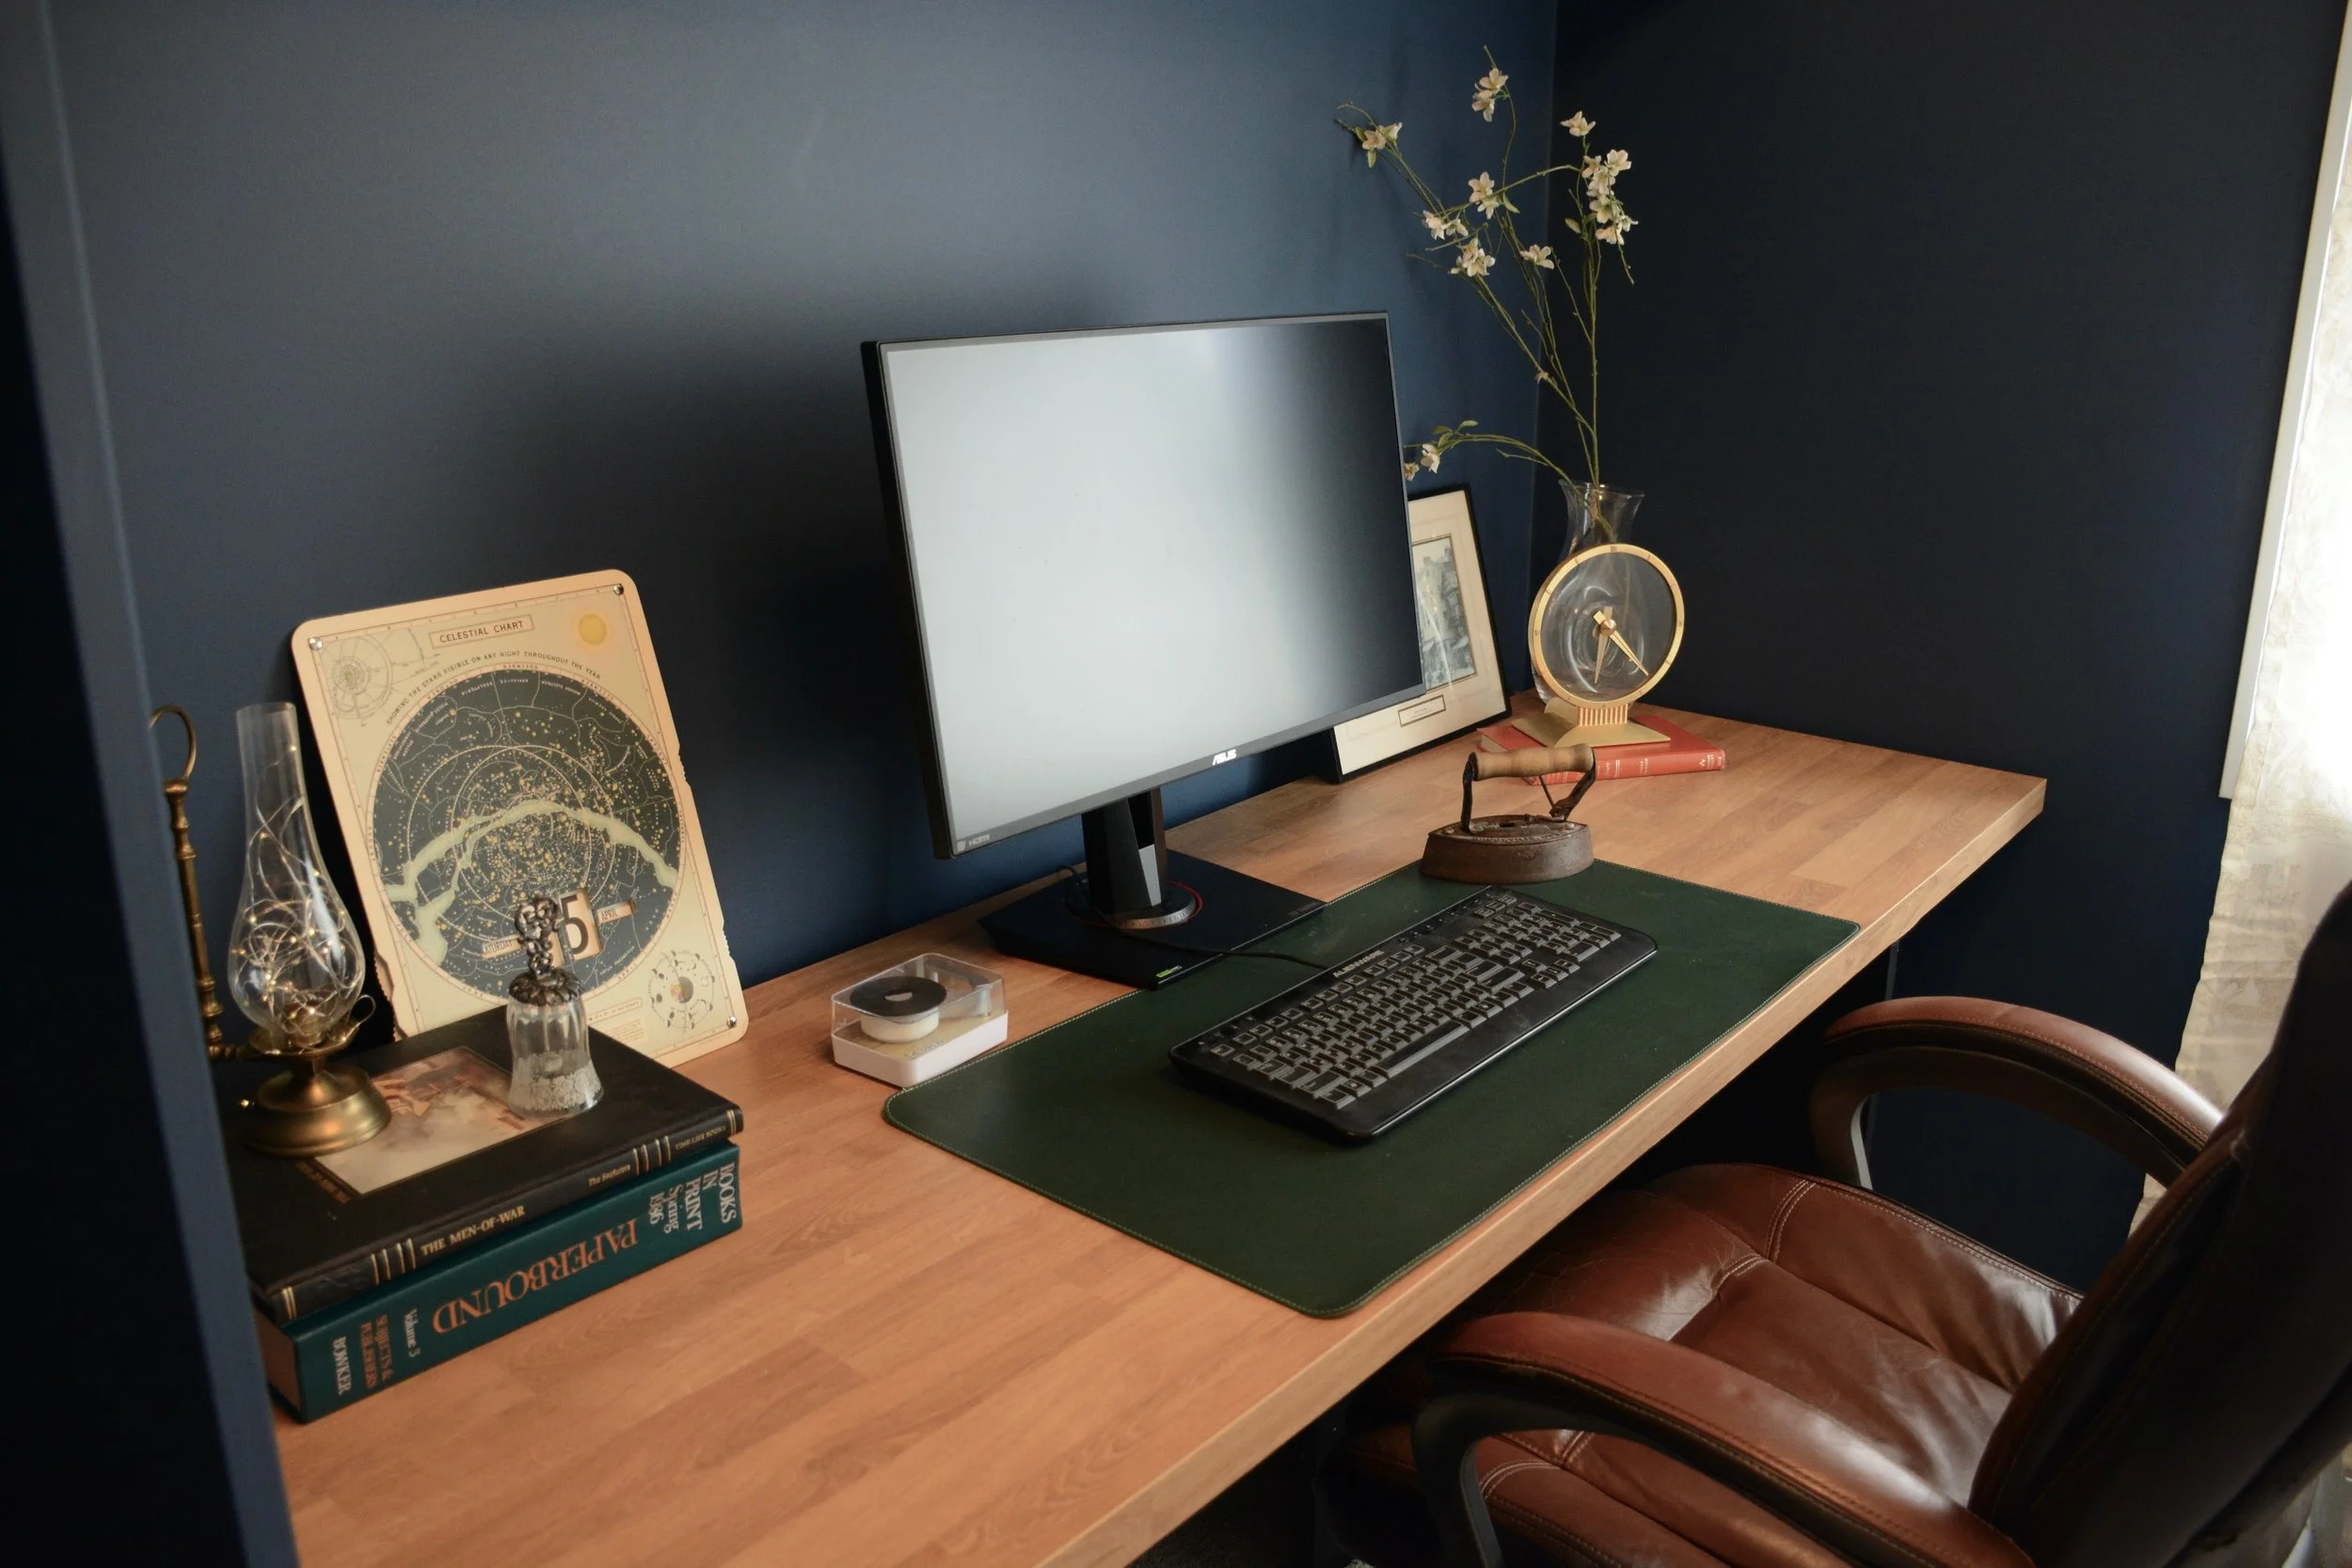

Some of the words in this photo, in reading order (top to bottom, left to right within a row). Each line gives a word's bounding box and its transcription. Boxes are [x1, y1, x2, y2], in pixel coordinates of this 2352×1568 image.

[439, 626, 489, 643] CELESTIAL
[493, 621, 524, 633] CHART
[386, 698, 410, 725] SHOWING
[408, 687, 421, 699] THE
[422, 672, 442, 689] STARS
[443, 659, 469, 674] VISIBLE
[471, 656, 482, 664] ON
[524, 651, 568, 664] THROUGHOUT
[571, 661, 582, 670] THE
[585, 668, 601, 679] YEAR
[1212, 748, 1237, 766] ASUS
[561, 894, 589, 956] 5
[601, 910, 619, 923] APRIL
[1333, 949, 1385, 978] ALIENWARE
[685, 1177, 703, 1230] PRINT
[702, 1169, 719, 1191] IN
[718, 1162, 738, 1224] BOOKS
[421, 1238, 446, 1256] THE
[449, 1205, 526, 1245] MEN-OF-WAR
[649, 1191, 665, 1225] 1986
[662, 1183, 684, 1234] Spring
[432, 1218, 639, 1335] PAPERBOUND
[405, 1308, 419, 1348] Volume
[332, 1336, 352, 1397] BOWKER
